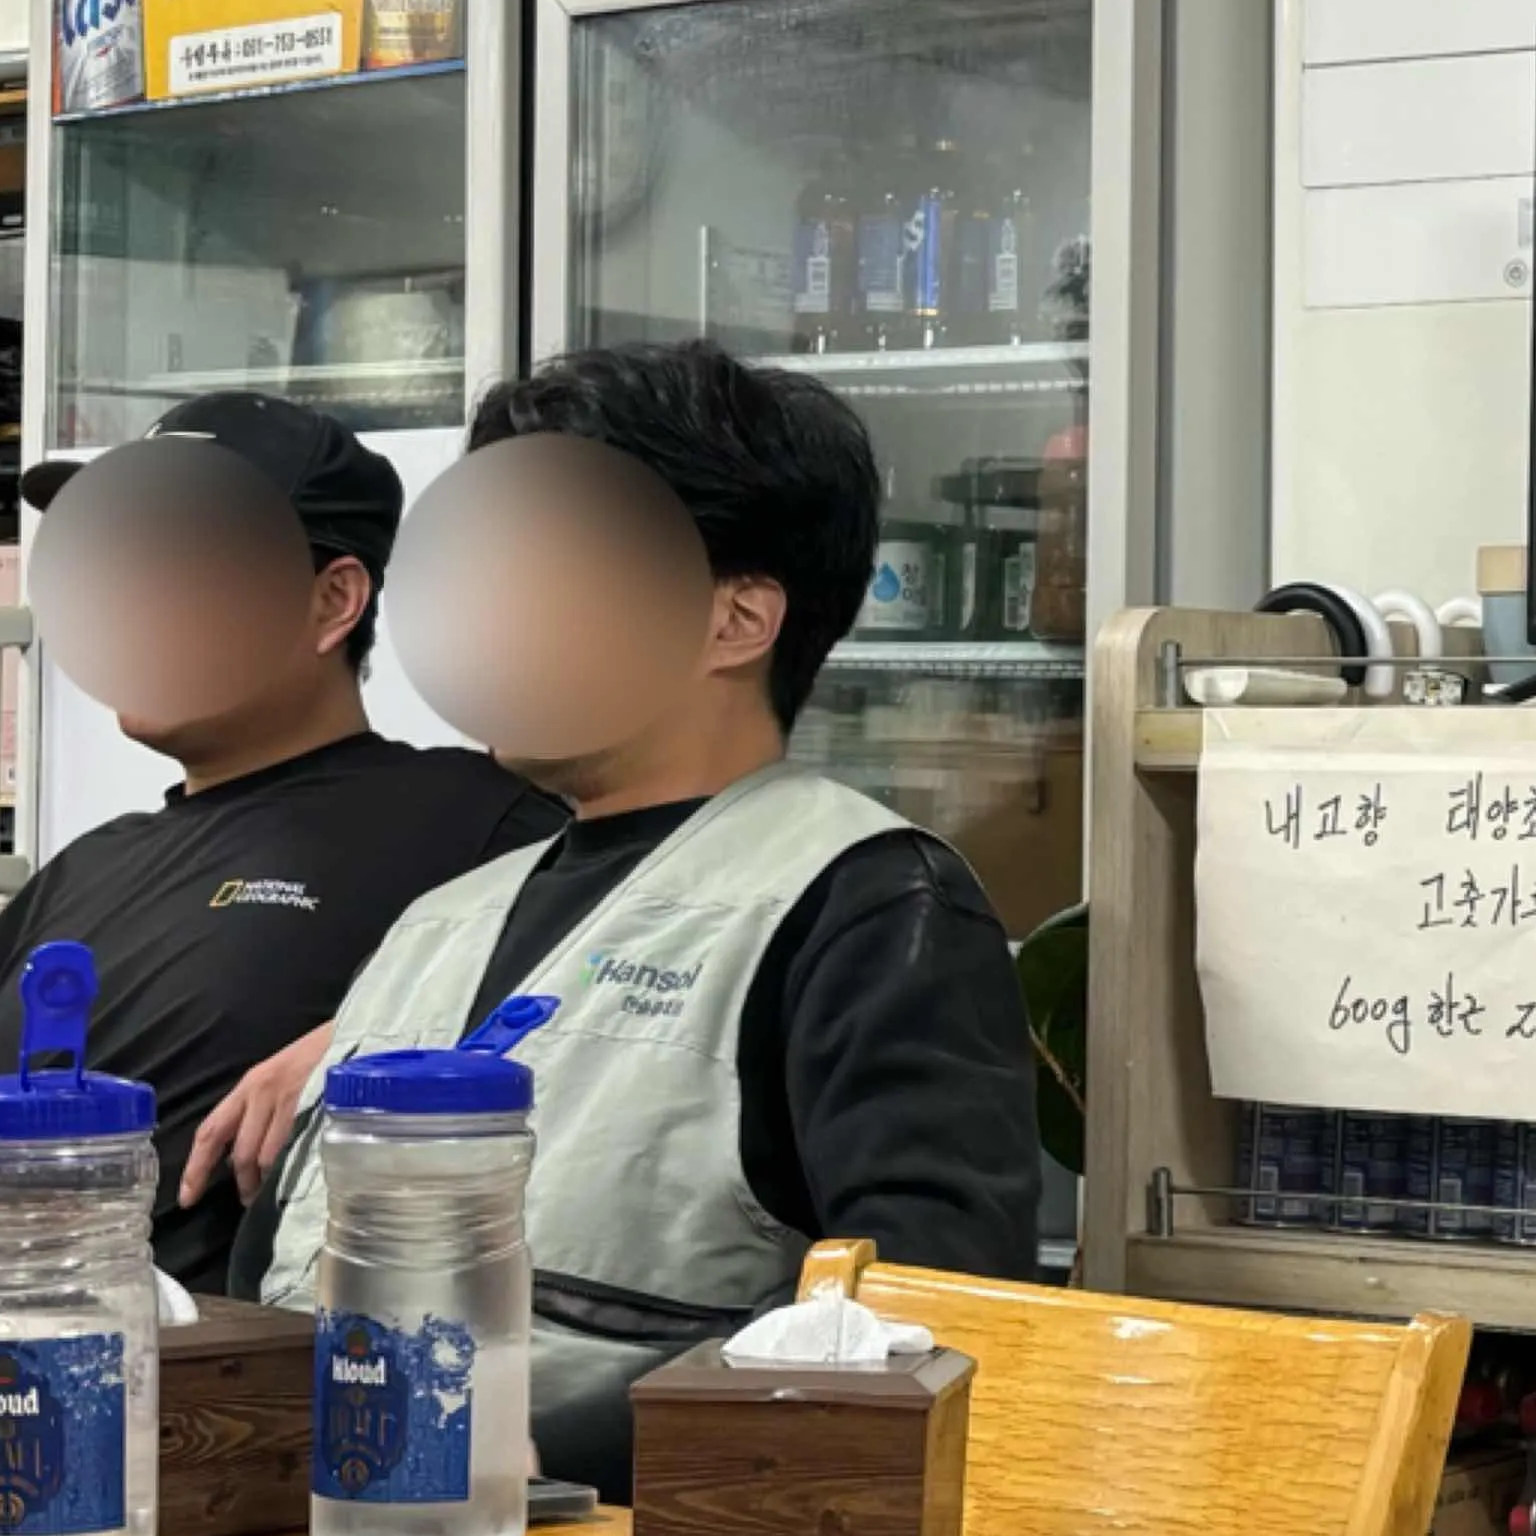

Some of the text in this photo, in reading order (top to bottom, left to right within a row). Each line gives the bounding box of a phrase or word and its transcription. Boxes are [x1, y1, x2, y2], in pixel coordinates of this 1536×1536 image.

[1263, 782, 1389, 850] 내고향
[595, 958, 705, 994] Hansol
[1327, 974, 1413, 1054] 600g
[1426, 970, 1486, 1039] 한근
[332, 1354, 388, 1387] Kloud
